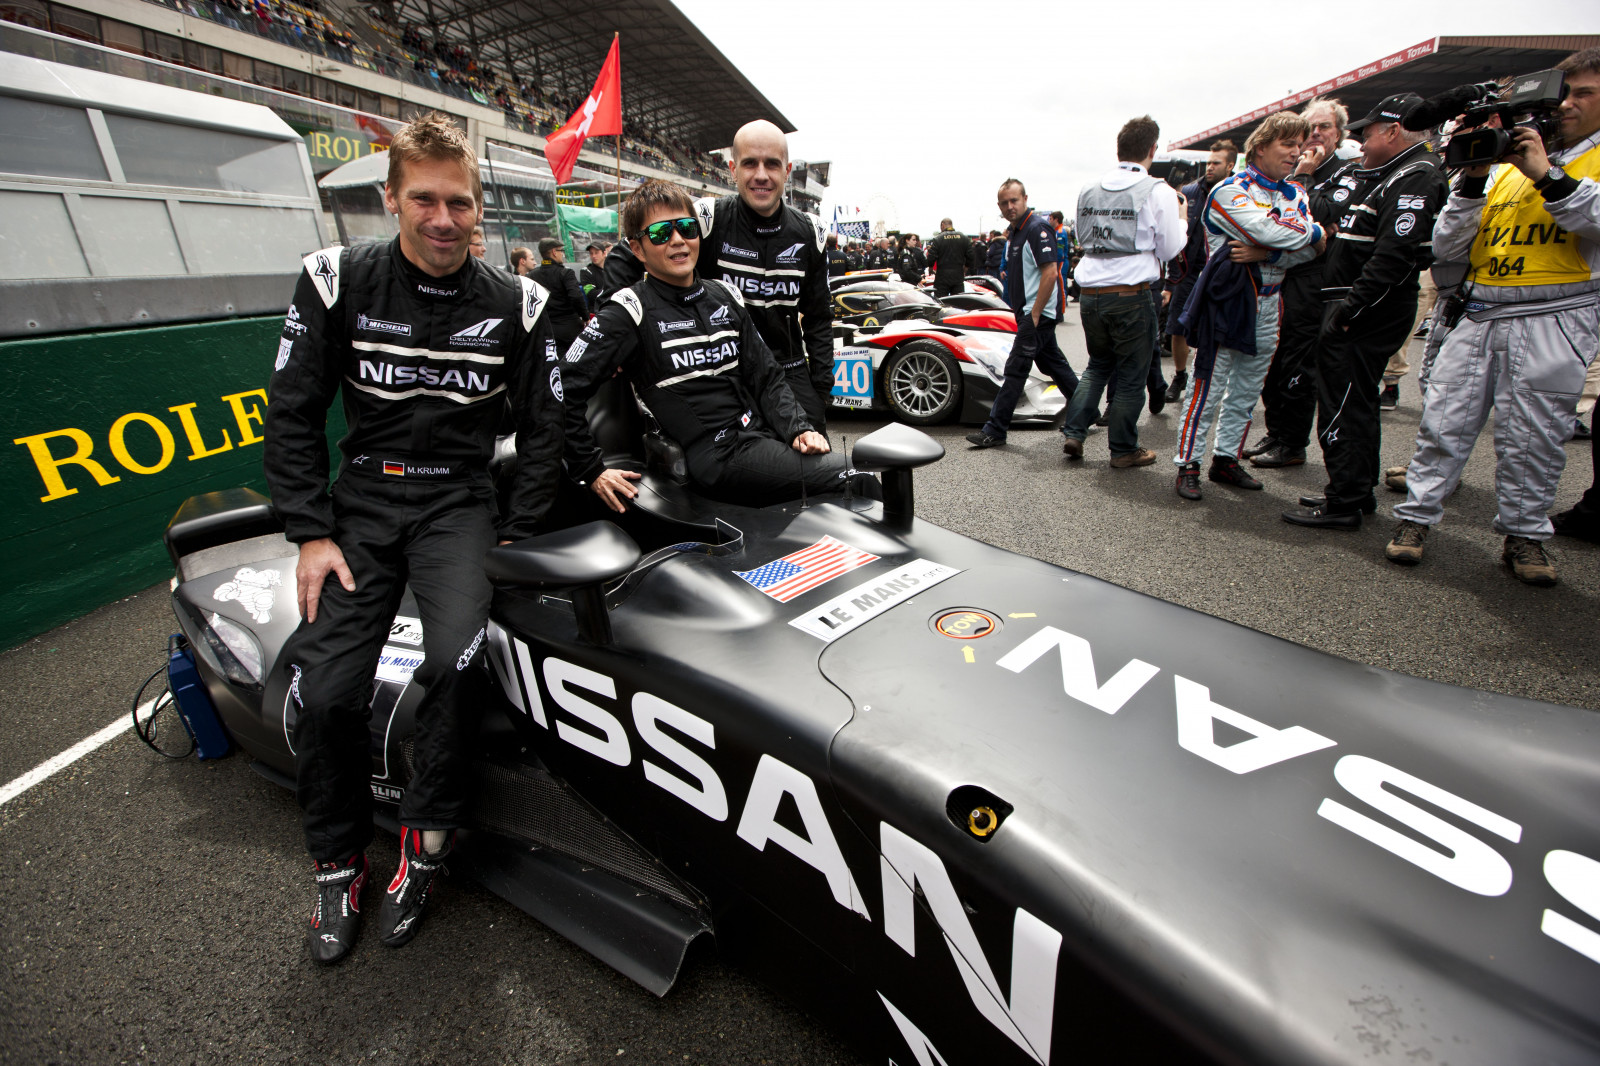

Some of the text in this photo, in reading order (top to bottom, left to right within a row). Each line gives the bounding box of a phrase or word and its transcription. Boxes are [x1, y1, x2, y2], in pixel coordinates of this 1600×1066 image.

[1336, 74, 1356, 87] TOTAL
[1357, 64, 1378, 79] TOTAL
[1381, 54, 1404, 70] TOTAL
[1407, 43, 1432, 59] TOTAL
[1081, 206, 1094, 217] 24
[1397, 199, 1426, 210] 56
[1092, 225, 1113, 241] TRACK
[1489, 256, 1525, 277] 064
[367, 320, 410, 333] MICHELIN
[359, 359, 491, 392] NISSAN
[834, 360, 870, 394] 40
[818, 573, 921, 630] LE MANS
[944, 612, 983, 634] TOW
[390, 657, 423, 668] MANS
